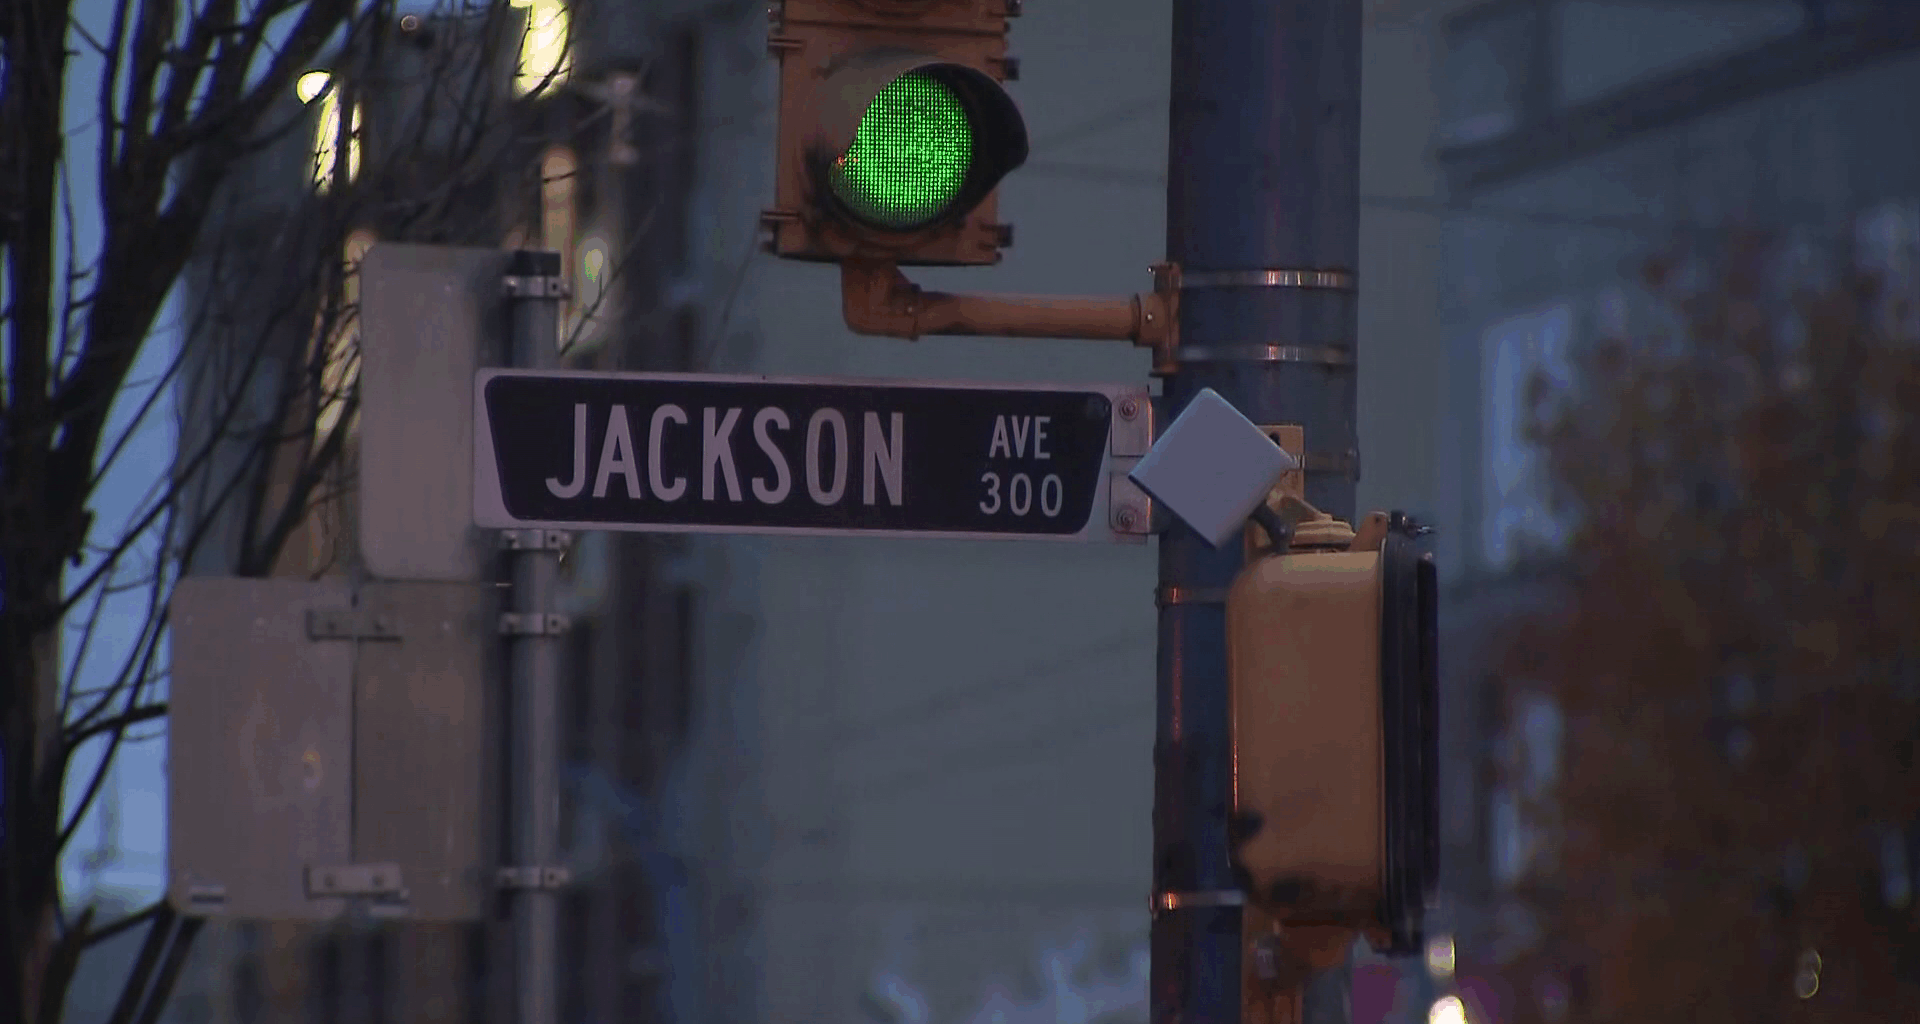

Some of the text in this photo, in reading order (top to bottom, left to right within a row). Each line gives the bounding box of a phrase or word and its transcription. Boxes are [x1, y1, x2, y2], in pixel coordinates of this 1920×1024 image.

[546, 402, 905, 506] JACKSON
[988, 414, 1051, 459] AVE
[979, 472, 1063, 518] 300
